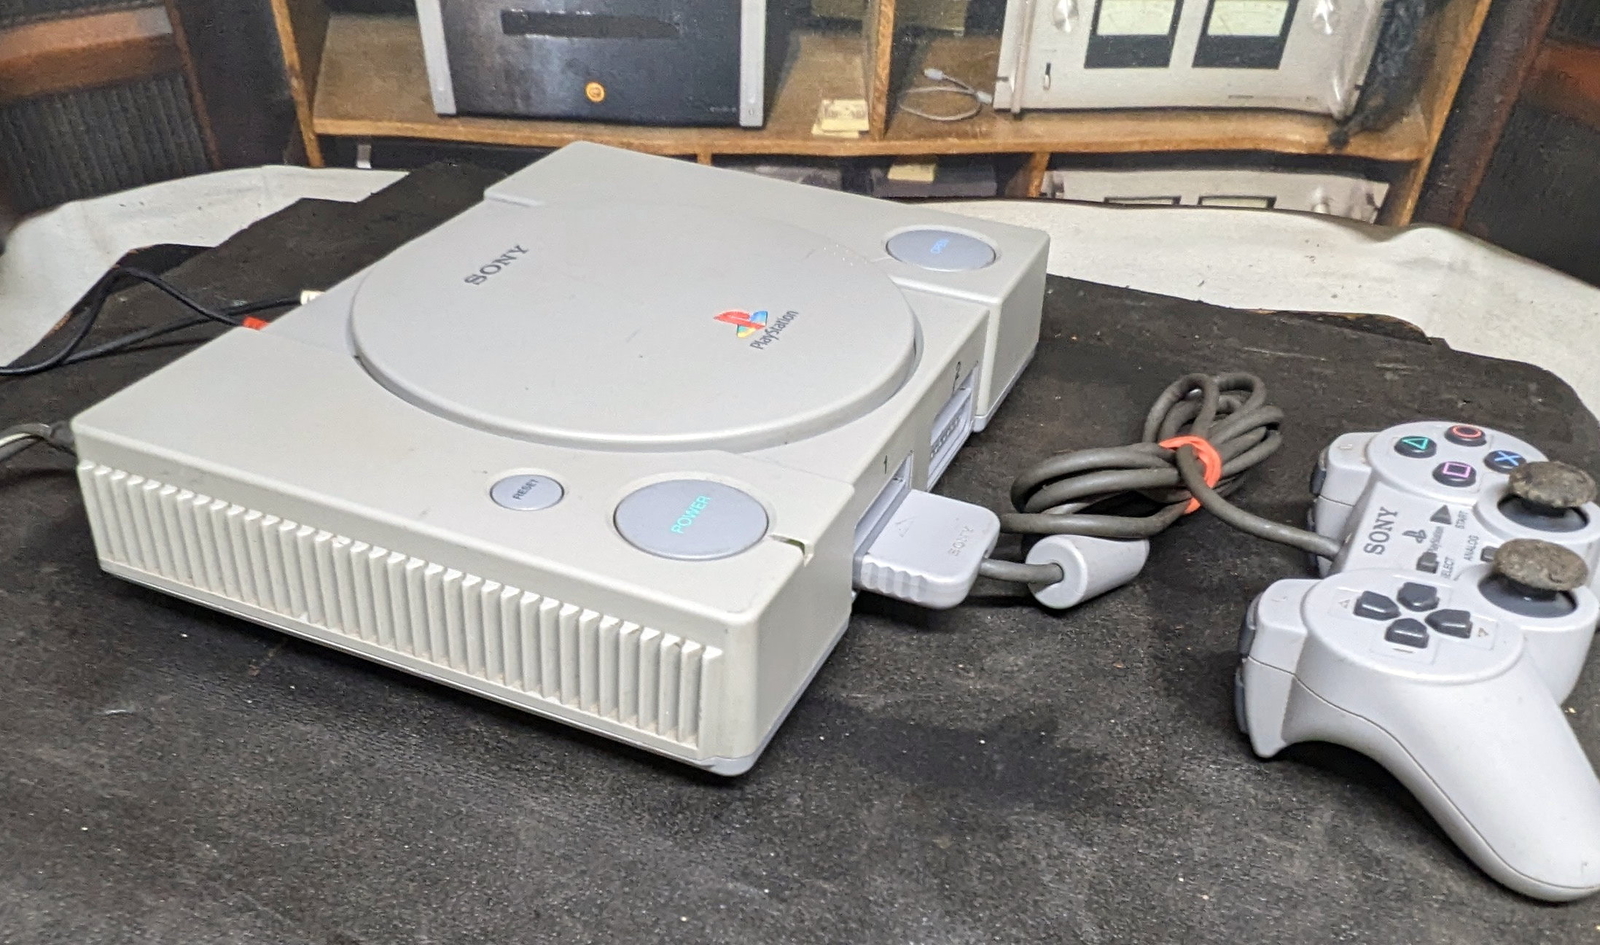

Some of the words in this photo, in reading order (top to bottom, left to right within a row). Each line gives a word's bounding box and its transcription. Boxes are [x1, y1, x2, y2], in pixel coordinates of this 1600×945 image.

[464, 244, 529, 286] SONY
[749, 310, 799, 350] PlayStation
[512, 478, 539, 500] RESET
[670, 494, 713, 534] POWER
[1363, 506, 1398, 555] SONY
[1454, 510, 1469, 530] START
[1463, 535, 1480, 562] ANALOG
